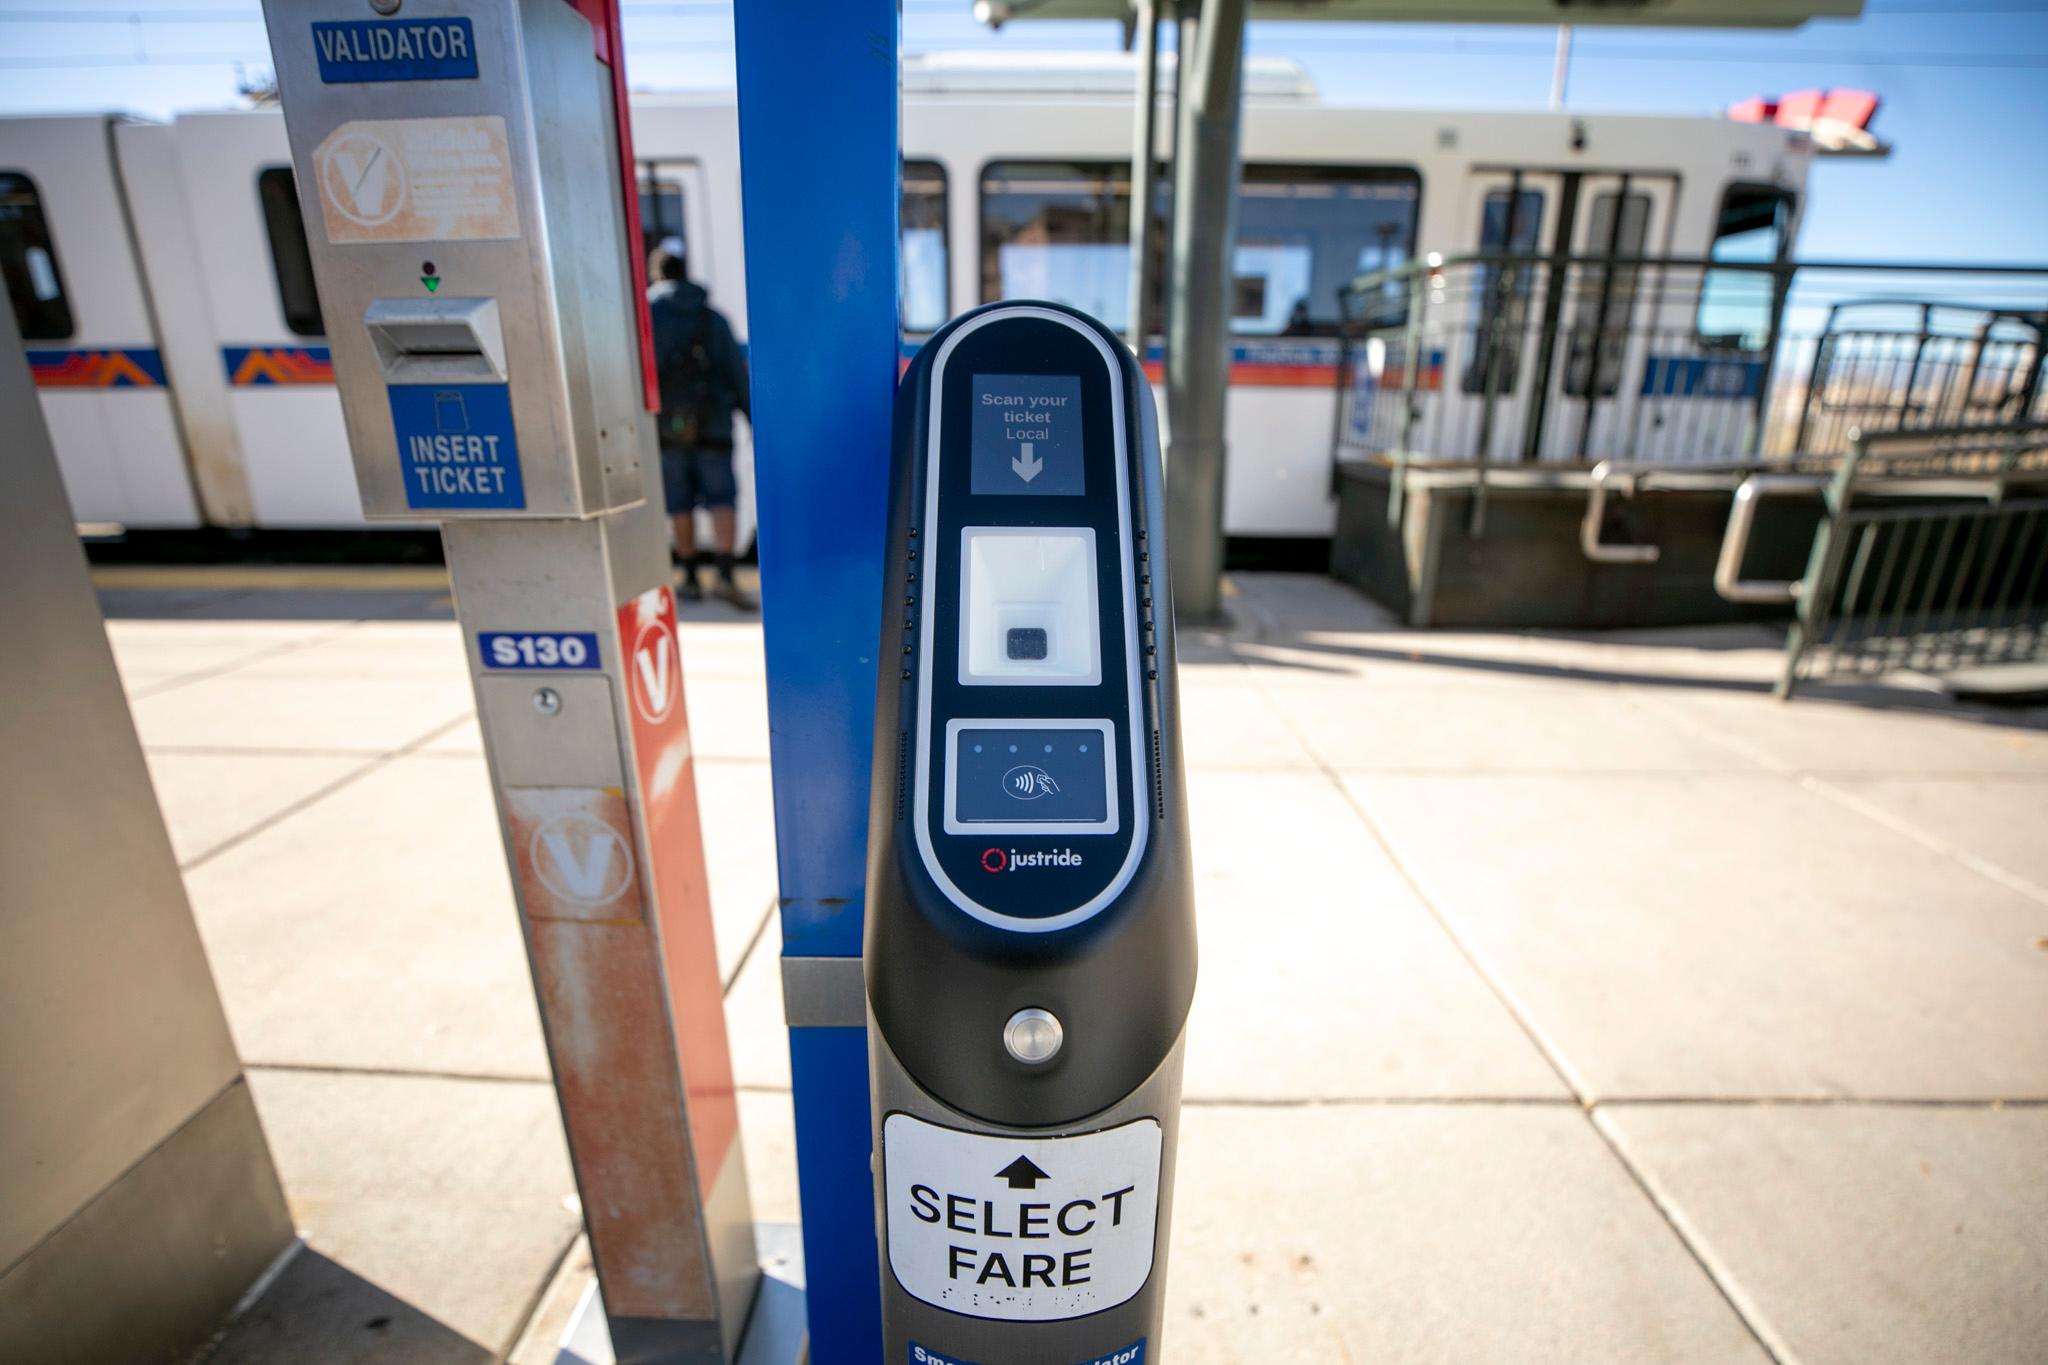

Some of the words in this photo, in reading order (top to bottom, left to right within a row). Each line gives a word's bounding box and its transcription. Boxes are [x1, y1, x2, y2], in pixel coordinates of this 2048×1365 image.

[316, 25, 468, 62] VALIDATOR
[981, 393, 1024, 406] Scan
[1029, 396, 1069, 408] your
[1003, 411, 1051, 423] ticket
[1006, 427, 1049, 440] Local
[409, 434, 499, 463] INSERT
[415, 466, 505, 494] TICKET
[492, 636, 587, 665] S130
[1009, 848, 1082, 871] justride
[910, 1184, 1135, 1239] SELECT
[949, 1245, 1092, 1288] FARE
